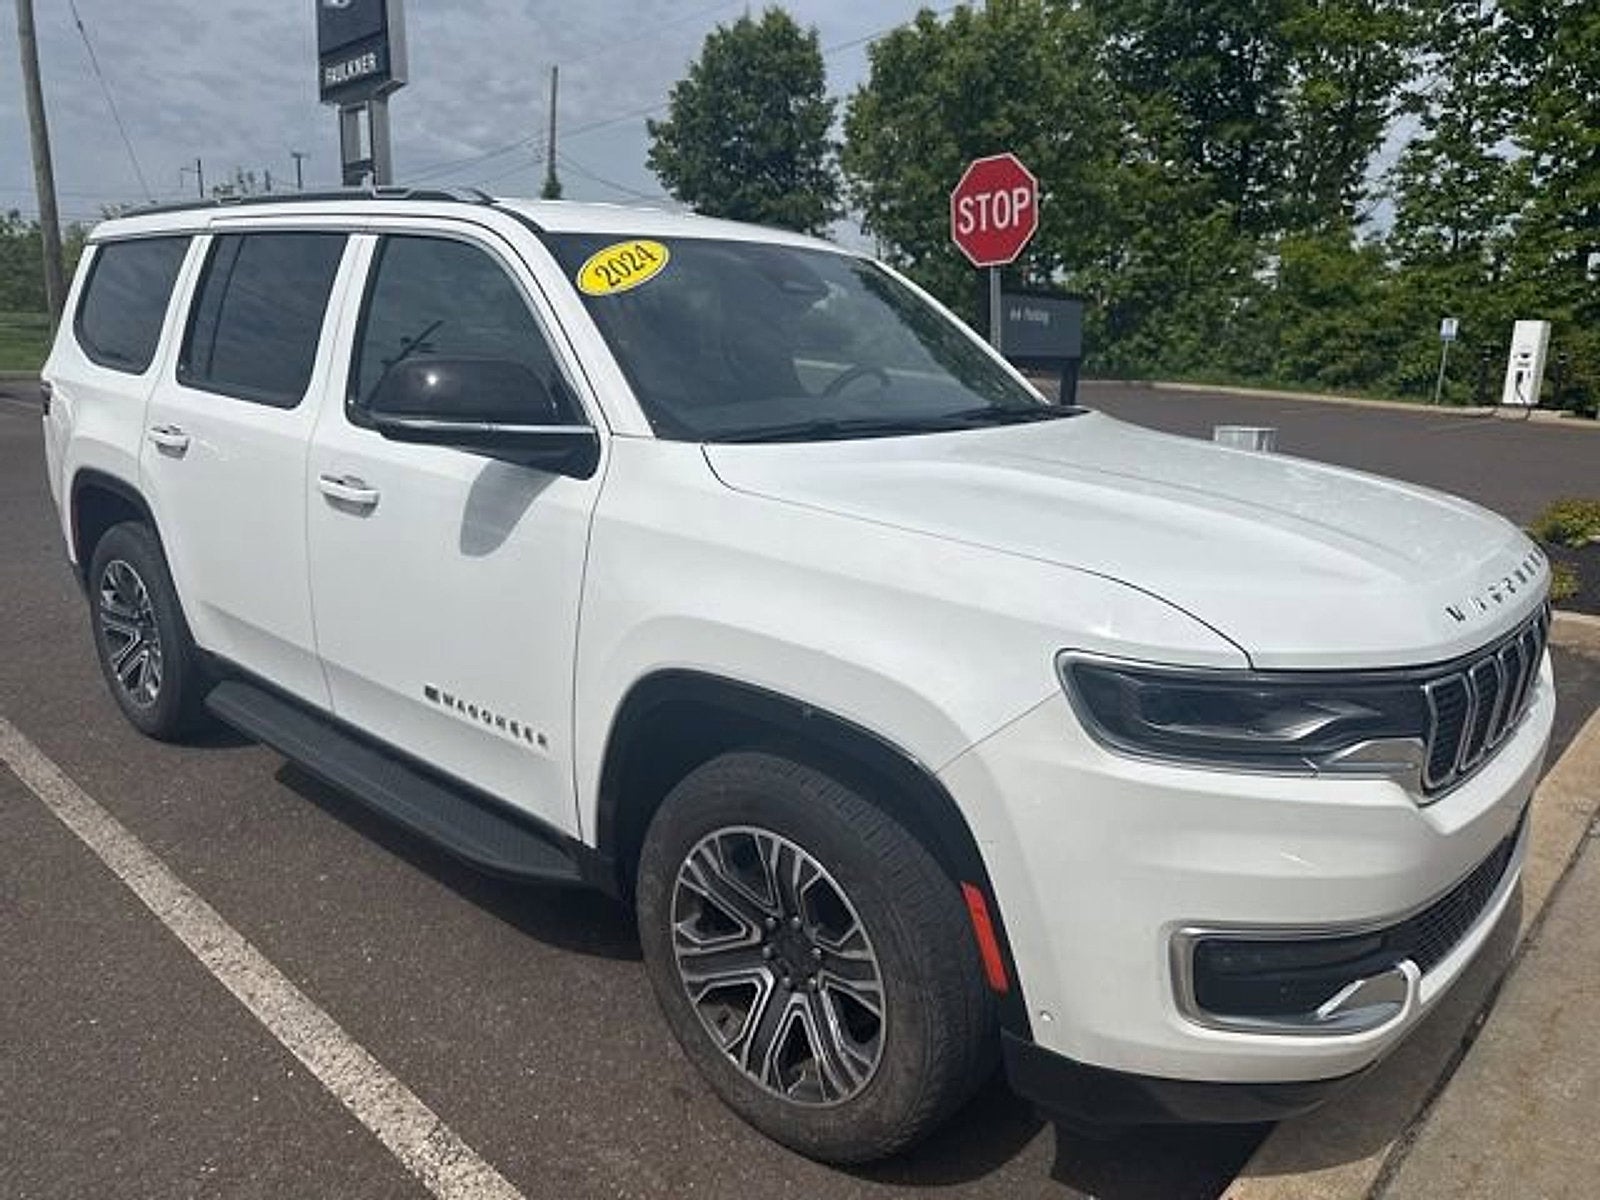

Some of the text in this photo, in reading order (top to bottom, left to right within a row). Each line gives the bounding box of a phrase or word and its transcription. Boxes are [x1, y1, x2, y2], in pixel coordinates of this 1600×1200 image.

[325, 52, 377, 86] FAULKNER
[959, 188, 1029, 234] STOP
[595, 245, 658, 287] 2024
